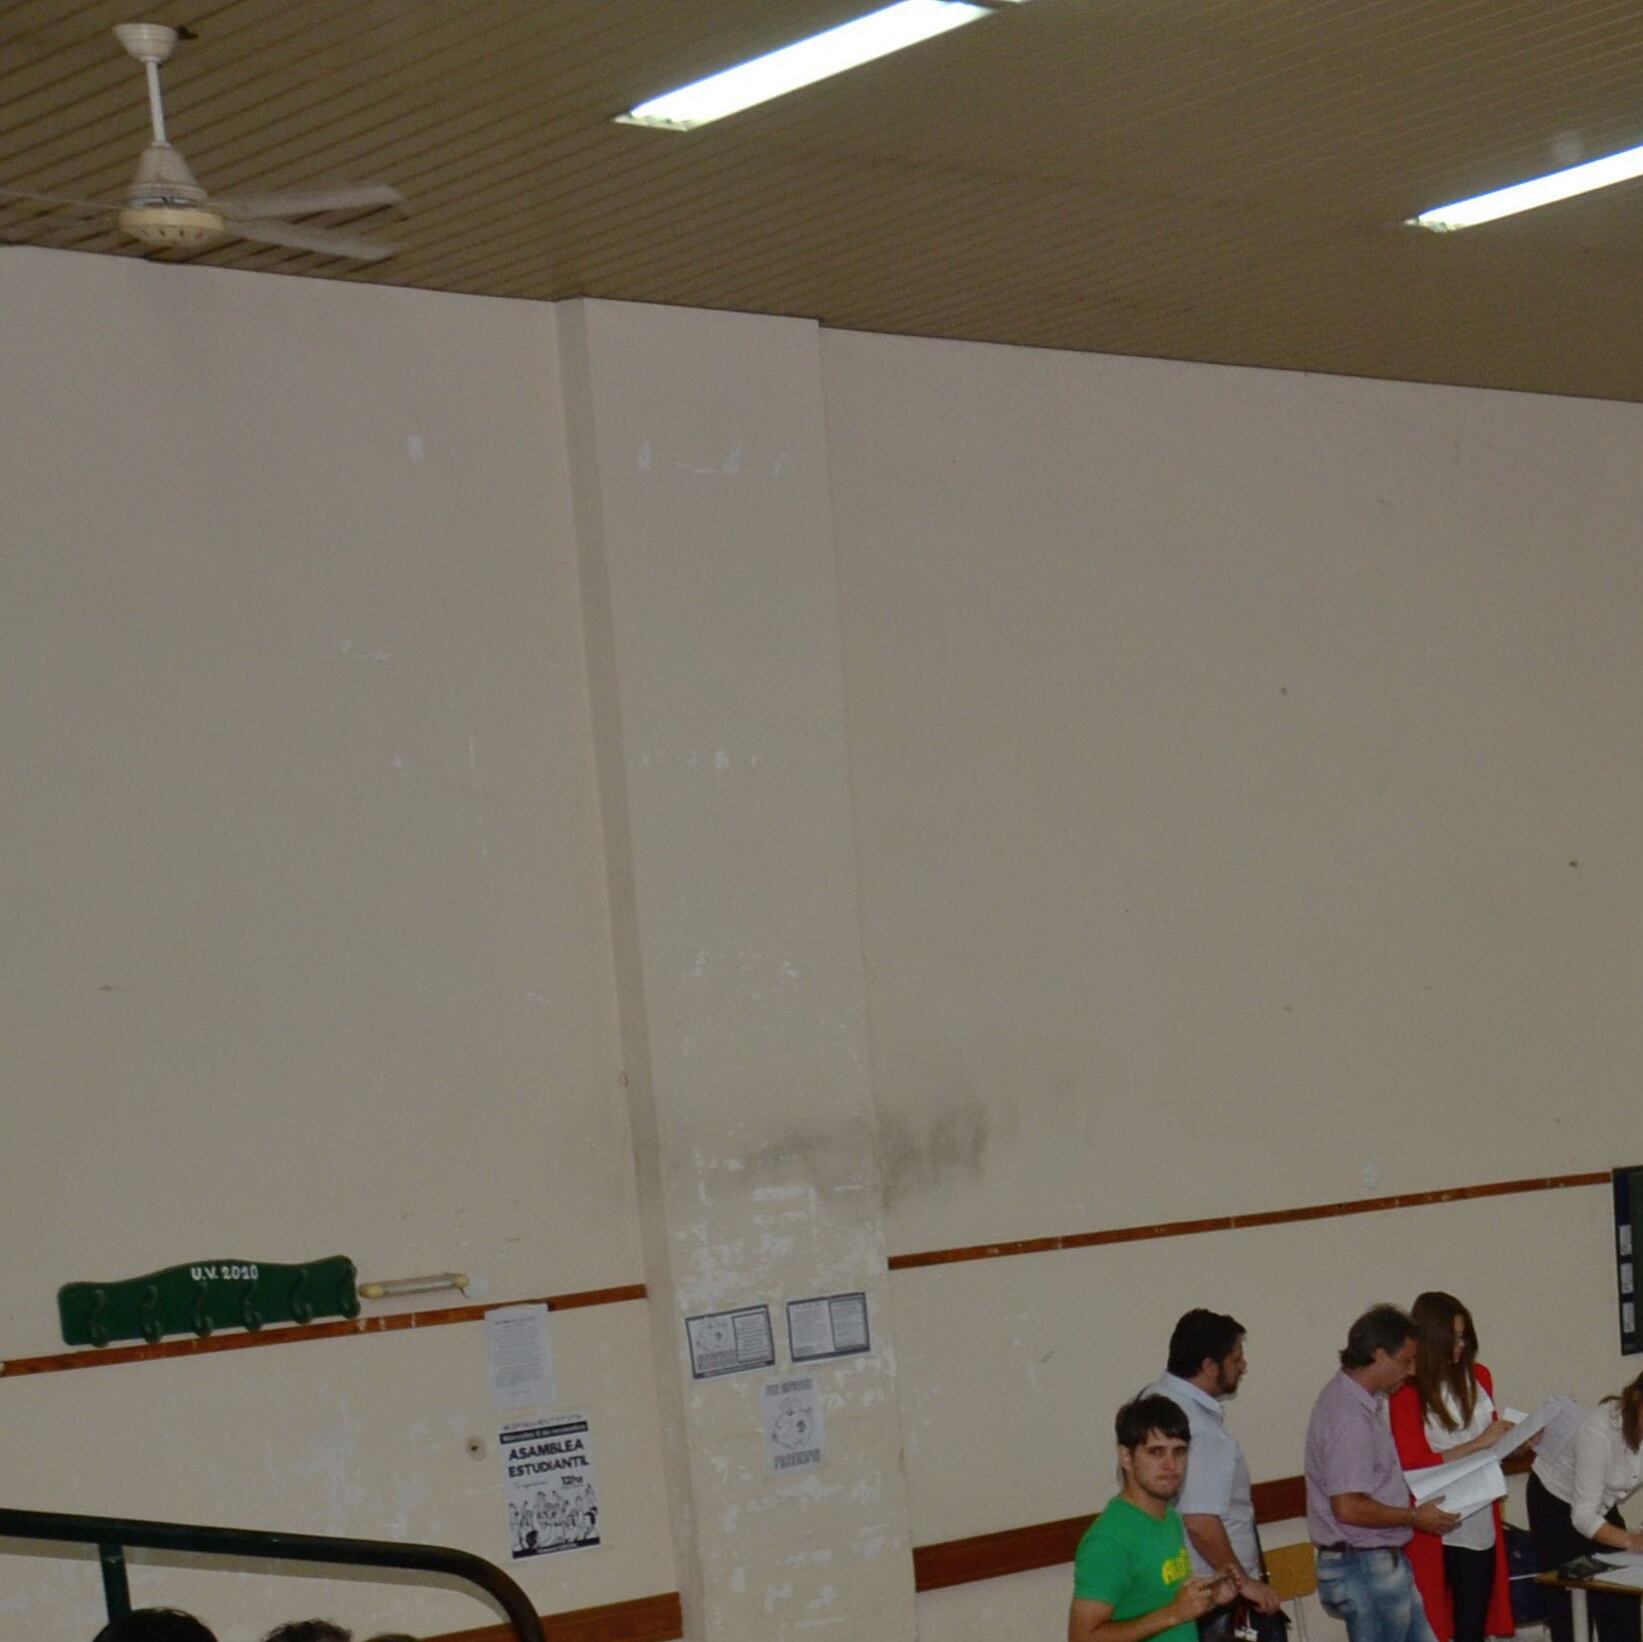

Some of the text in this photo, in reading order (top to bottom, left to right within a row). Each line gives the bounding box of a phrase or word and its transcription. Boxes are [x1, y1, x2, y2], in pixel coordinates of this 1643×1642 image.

[221, 1264, 259, 1280] 2010
[508, 1438, 584, 1461] ASAMBLEA
[508, 1455, 589, 1478] ESTUDIANTIL
